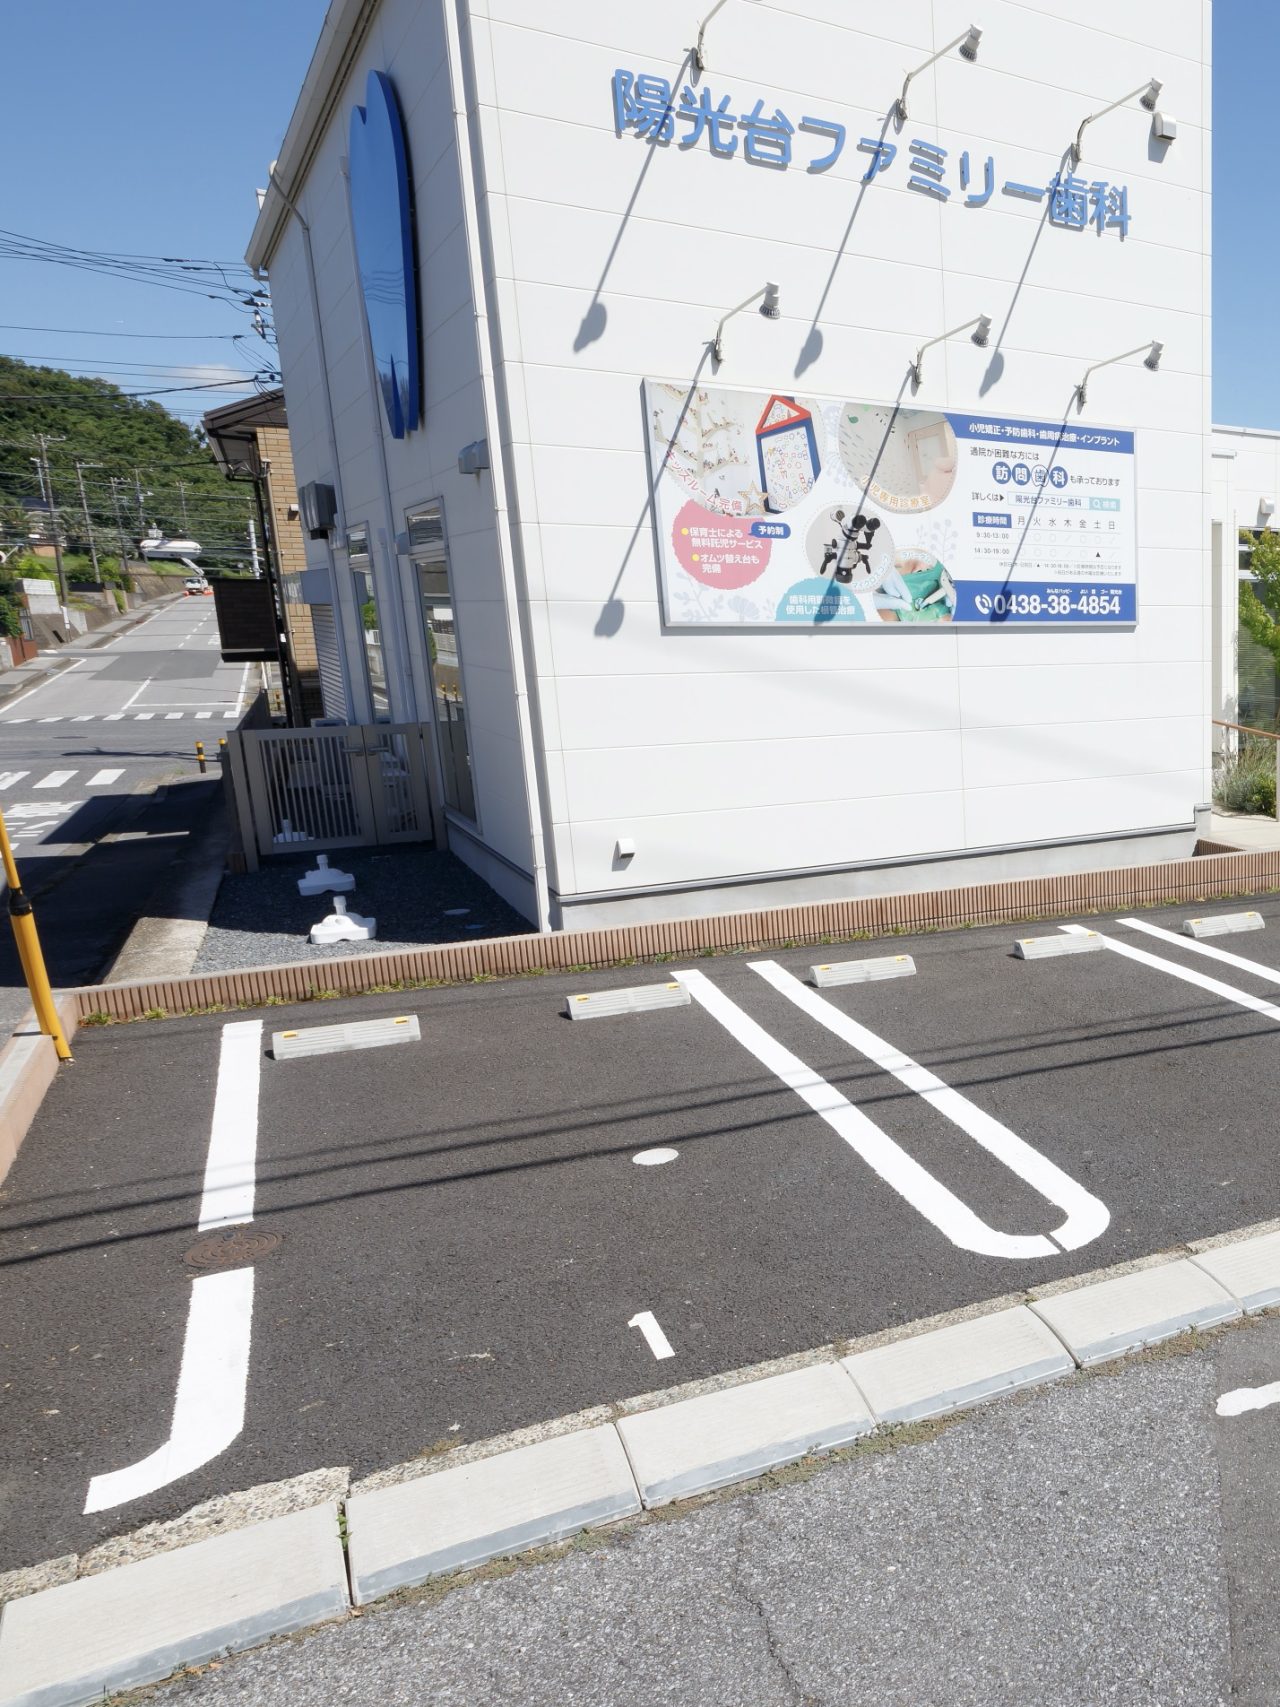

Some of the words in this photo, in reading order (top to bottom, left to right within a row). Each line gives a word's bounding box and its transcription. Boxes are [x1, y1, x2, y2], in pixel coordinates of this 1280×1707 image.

[615, 68, 1132, 237] 陽光台ファミリー歯科
[970, 446, 1039, 460] 通院が困難な方には
[994, 464, 1066, 487] 訪問歯科
[971, 491, 999, 502] 詳しくは
[1015, 494, 1082, 507] 陽光台ファミリー歯科
[689, 527, 743, 538] 保育士による
[758, 526, 784, 536] 予約制
[691, 538, 763, 549] 無料託児サービス
[700, 554, 760, 564] オムツ替え台も
[993, 593, 1121, 615] 0438-38-4854
[627, 1310, 676, 1361] 1
